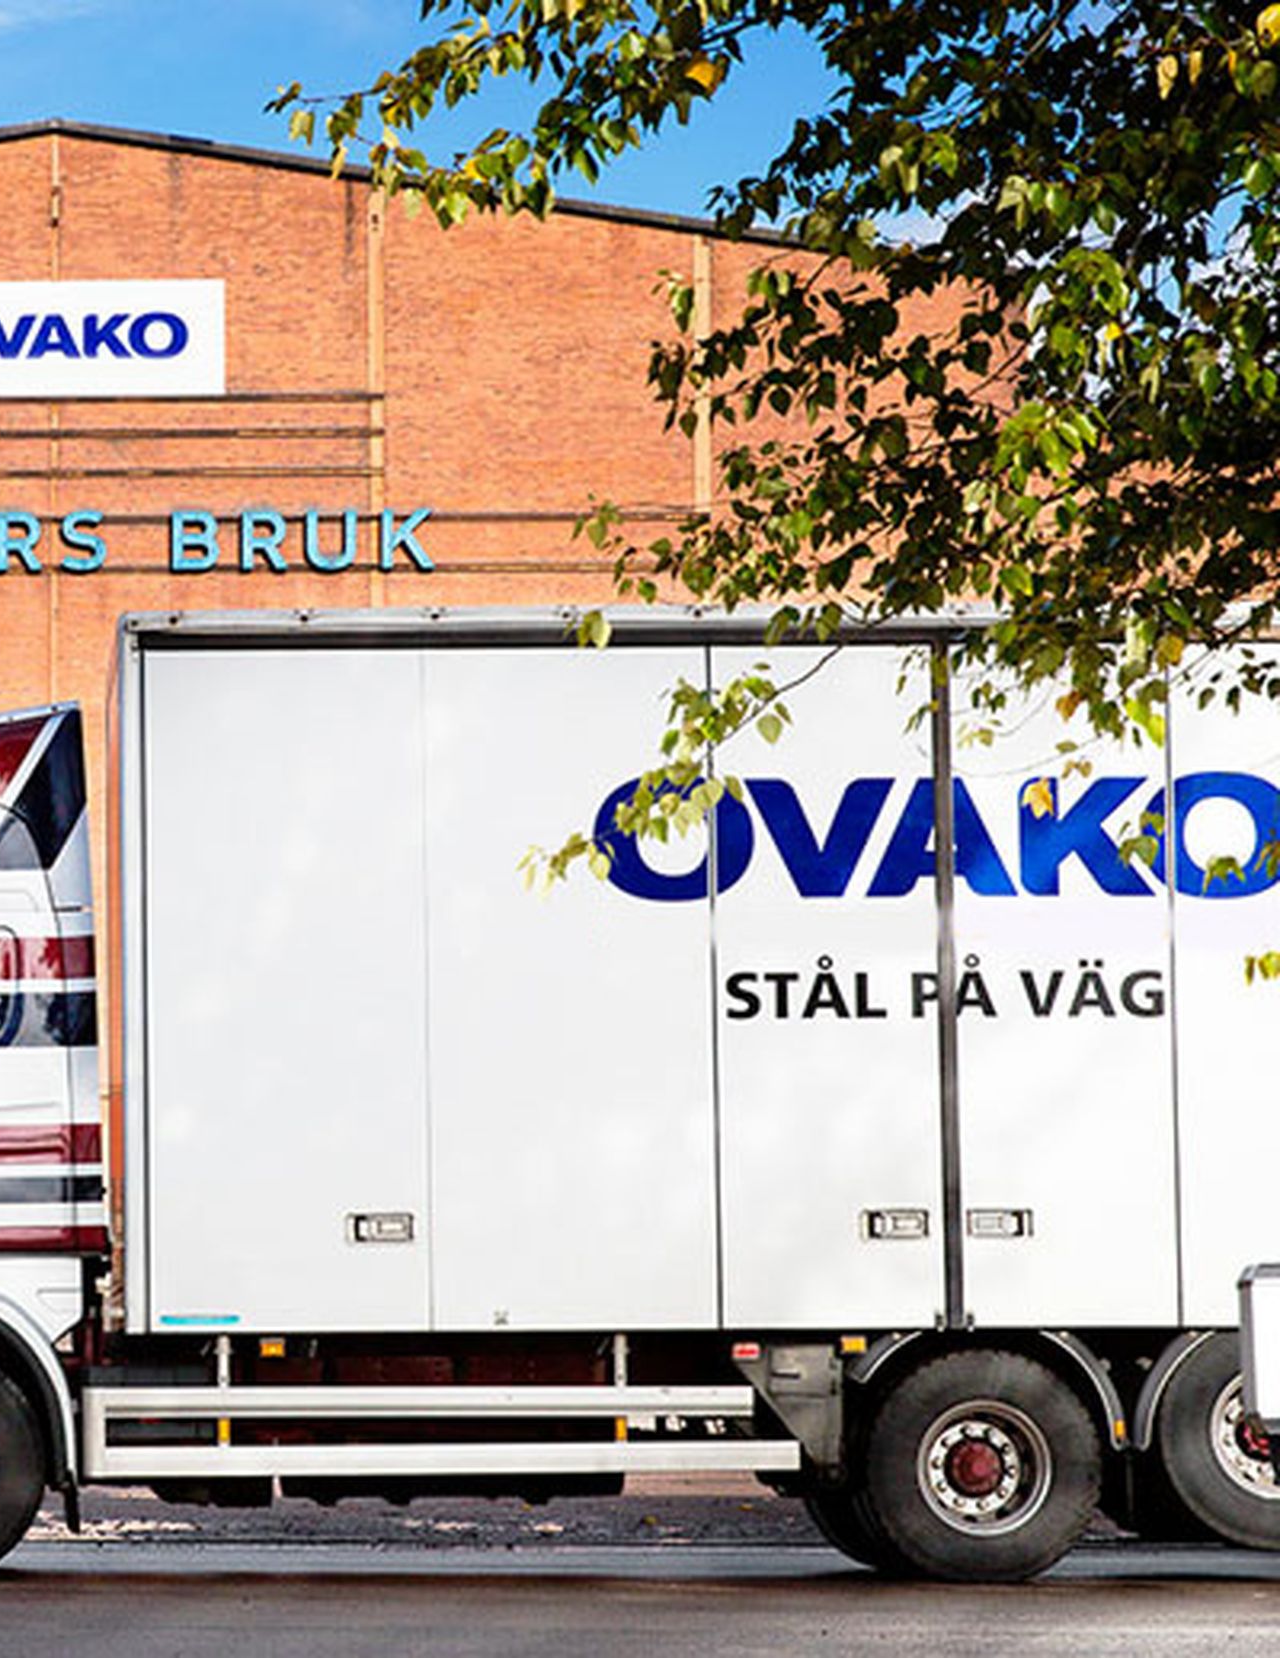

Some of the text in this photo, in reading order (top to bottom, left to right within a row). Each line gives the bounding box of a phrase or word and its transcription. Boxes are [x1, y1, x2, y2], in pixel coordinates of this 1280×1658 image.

[168, 510, 436, 573] BRUK
[593, 771, 1280, 901] OVAKO
[725, 954, 1166, 1019] STÅL PÅ VÄG
